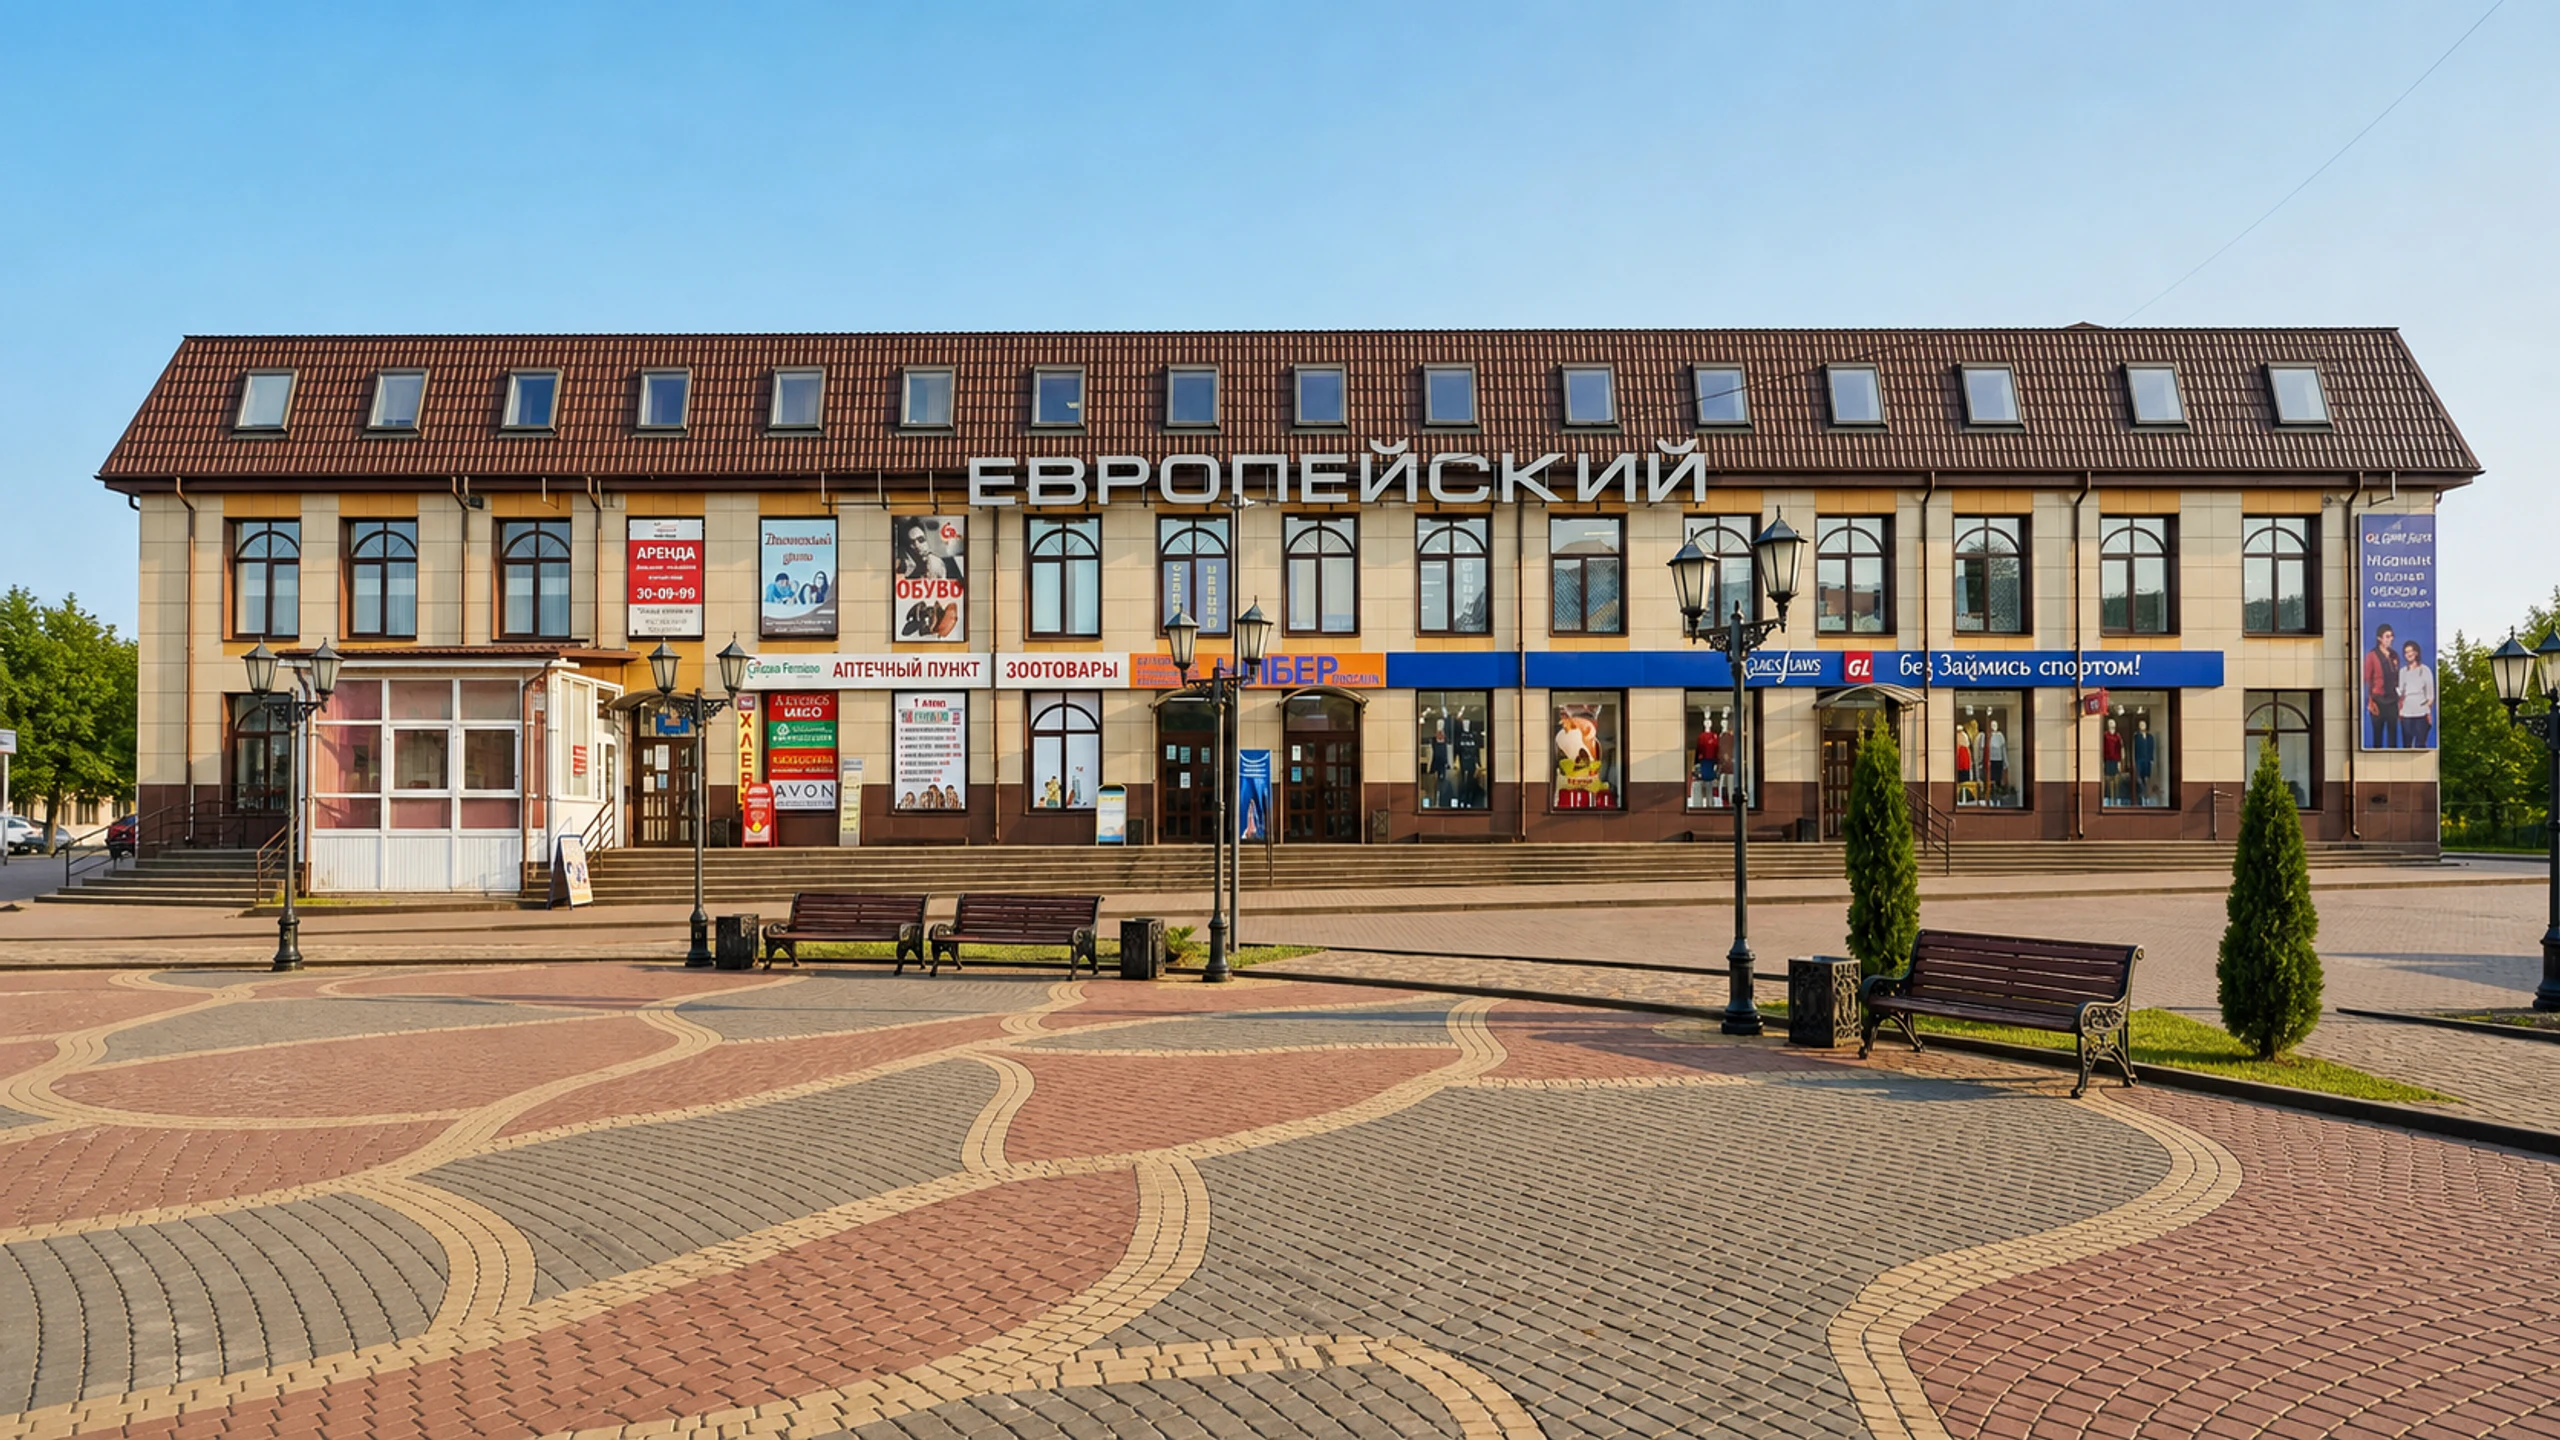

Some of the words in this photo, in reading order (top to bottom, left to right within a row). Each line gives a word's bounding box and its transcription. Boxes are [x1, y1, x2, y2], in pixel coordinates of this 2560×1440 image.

[968, 438, 1707, 505] ЕВРОПЕЙСКИЙ
[636, 546, 696, 562] АРЕНДА
[832, 657, 923, 678] АПТЕЧНЫЙ
[927, 659, 981, 678] ПУНКТ
[1006, 661, 1119, 679] ЗООТОВАРЫ
[774, 784, 834, 798] AVON
